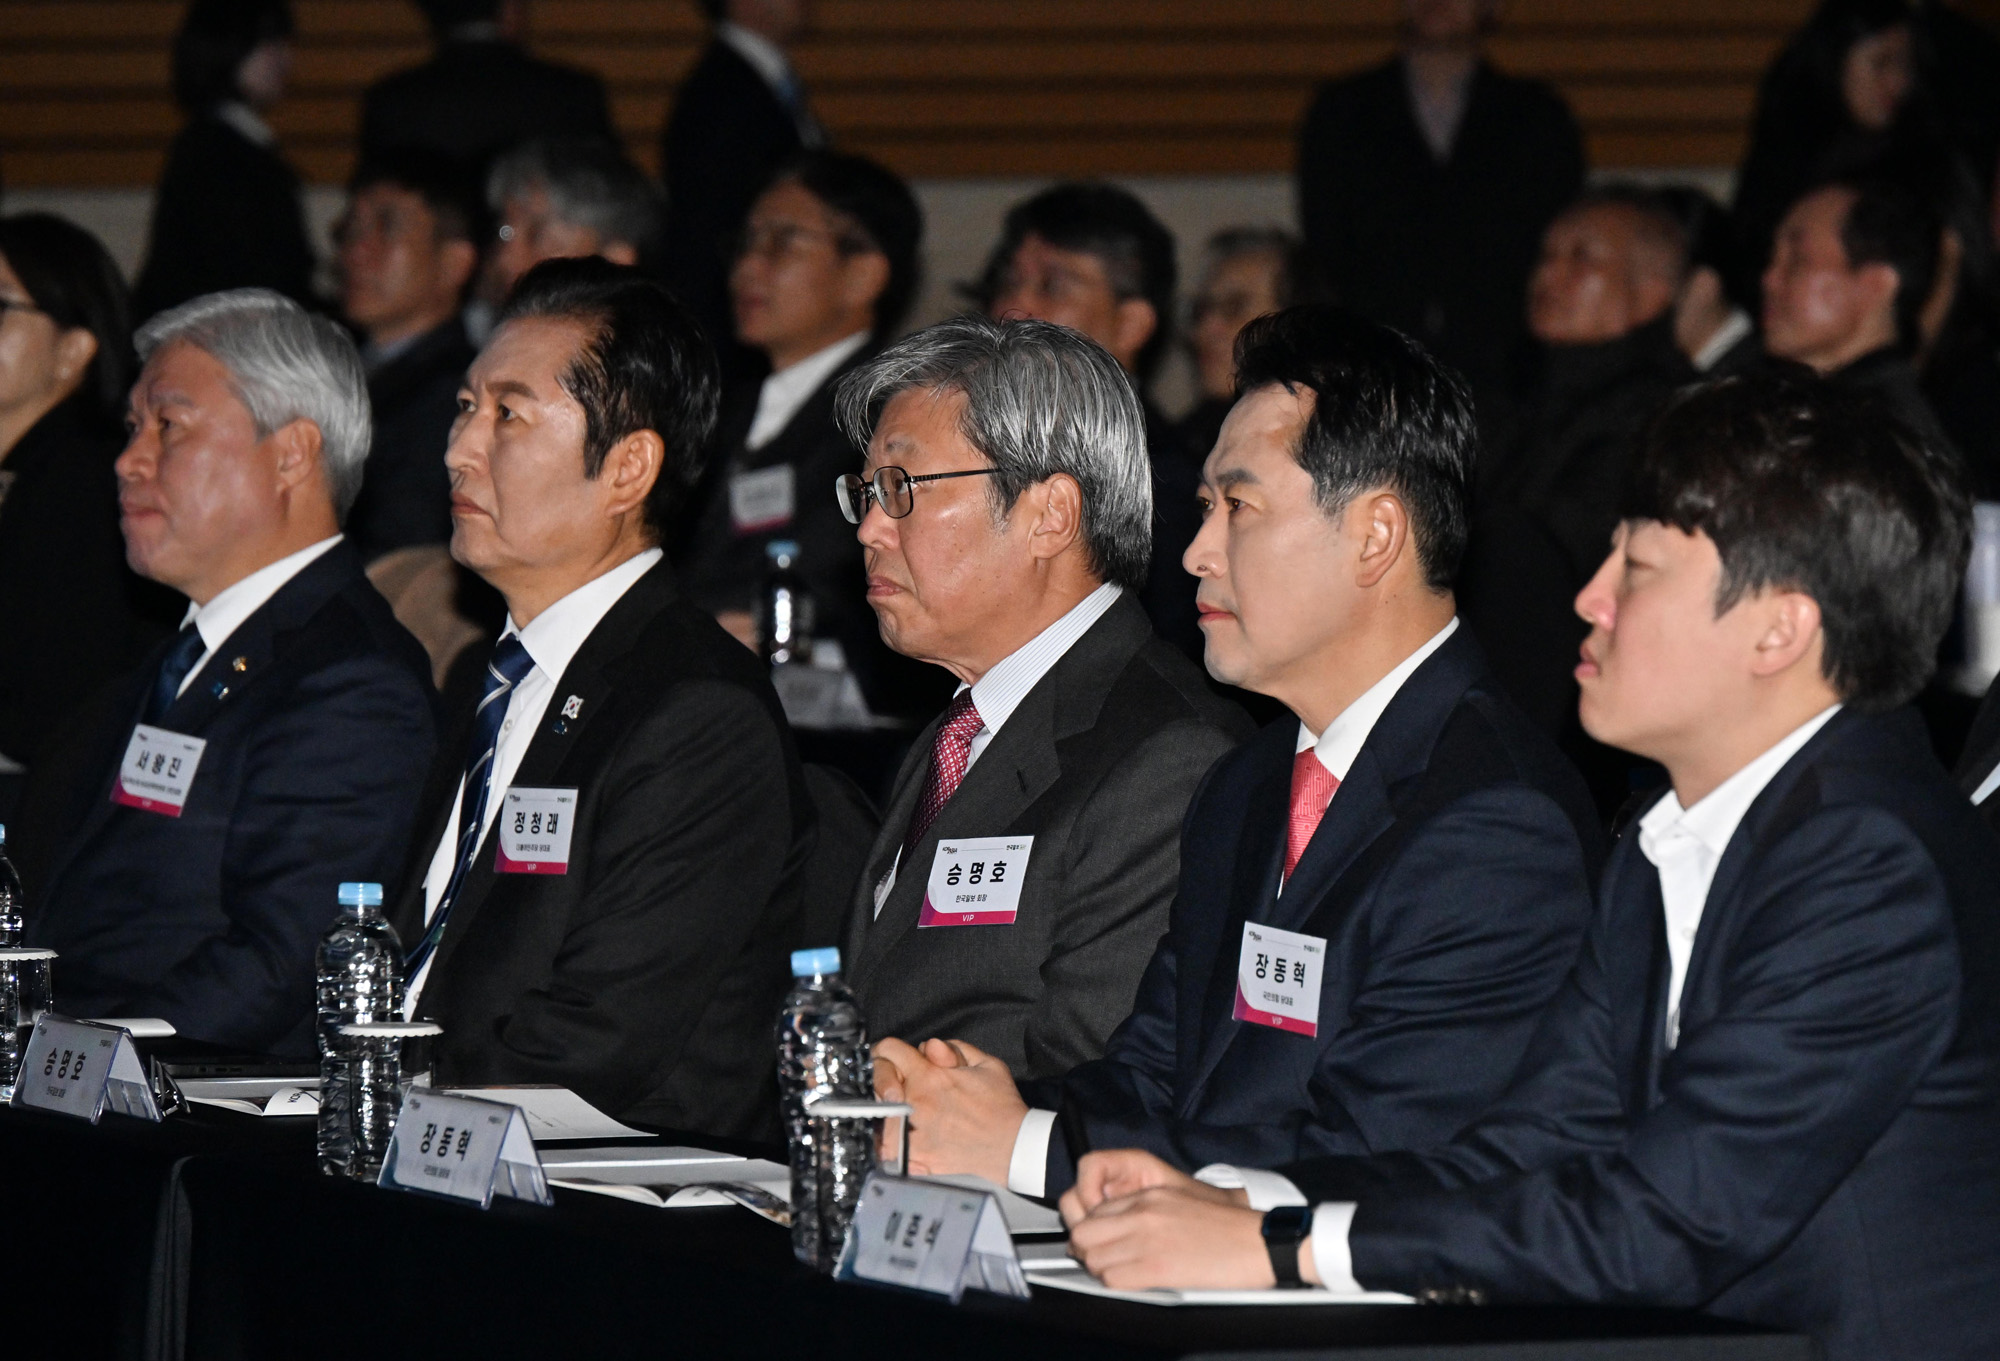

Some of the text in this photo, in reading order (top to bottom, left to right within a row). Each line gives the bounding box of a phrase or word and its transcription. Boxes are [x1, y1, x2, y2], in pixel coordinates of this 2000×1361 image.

[514, 811, 559, 835] 정청래
[527, 863, 537, 871] VIP
[946, 860, 1007, 886] 승명호
[955, 894, 988, 903] 한국일보 회장
[1255, 953, 1306, 988] 장동혁
[44, 1047, 87, 1080] 승명호
[420, 1123, 473, 1161] 장동혁
